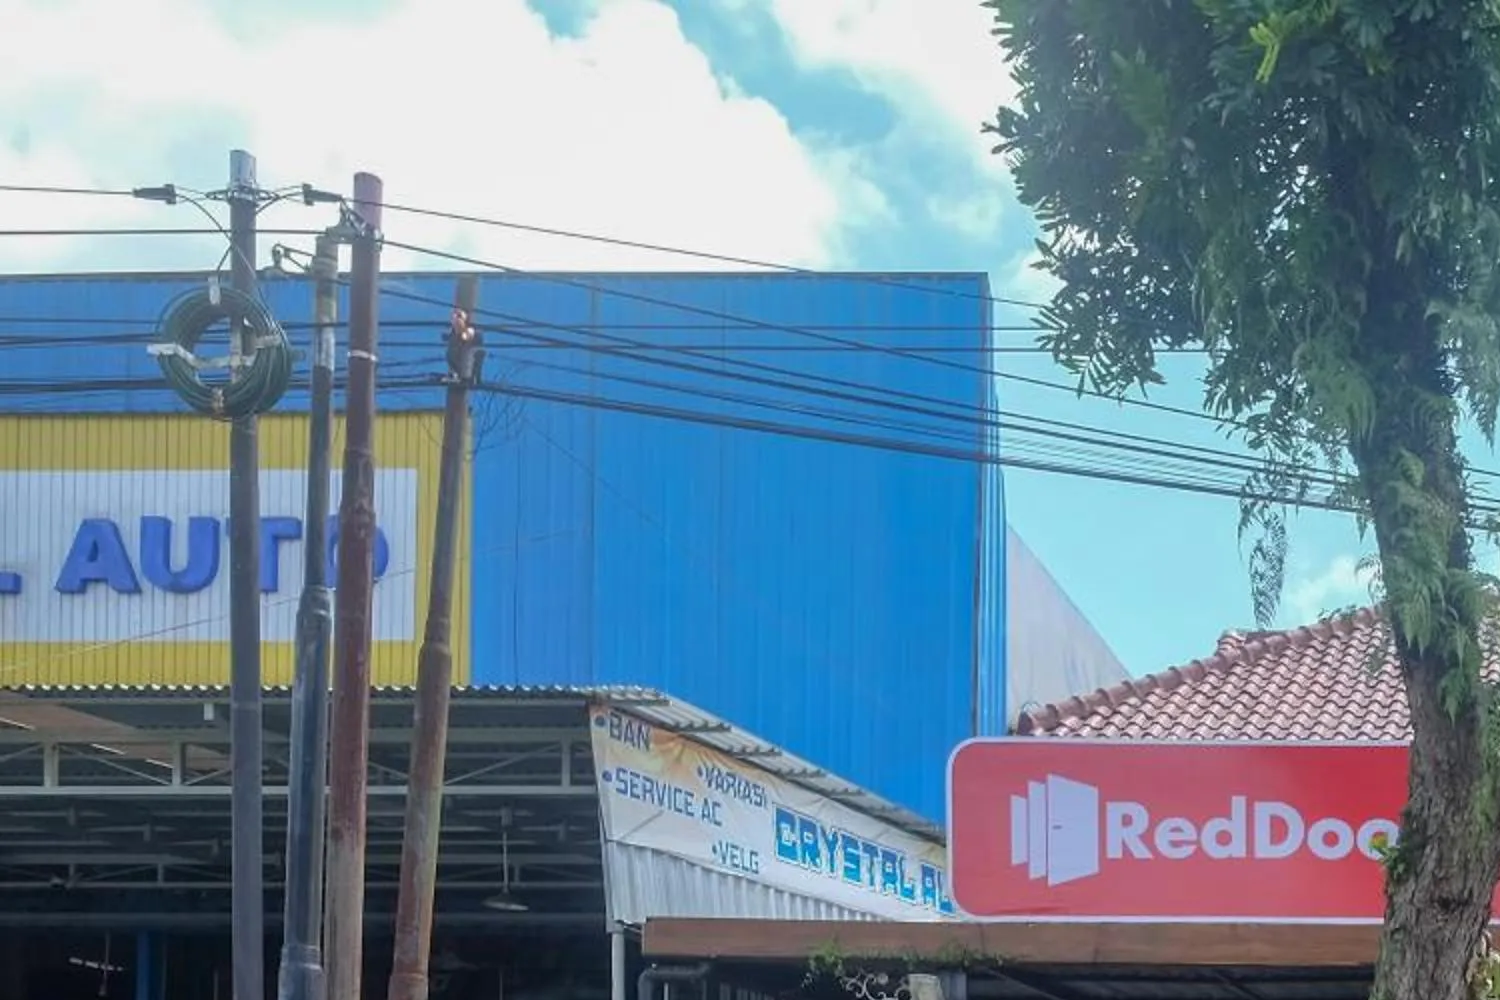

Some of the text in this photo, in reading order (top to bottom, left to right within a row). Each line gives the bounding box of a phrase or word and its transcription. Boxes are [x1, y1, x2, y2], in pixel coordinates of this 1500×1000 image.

[609, 711, 652, 752] BAN
[615, 767, 723, 827] SERVICE AC
[718, 839, 759, 875] VELG
[772, 801, 918, 906] CRYSTAL
[1105, 795, 1402, 861] RedDoo
